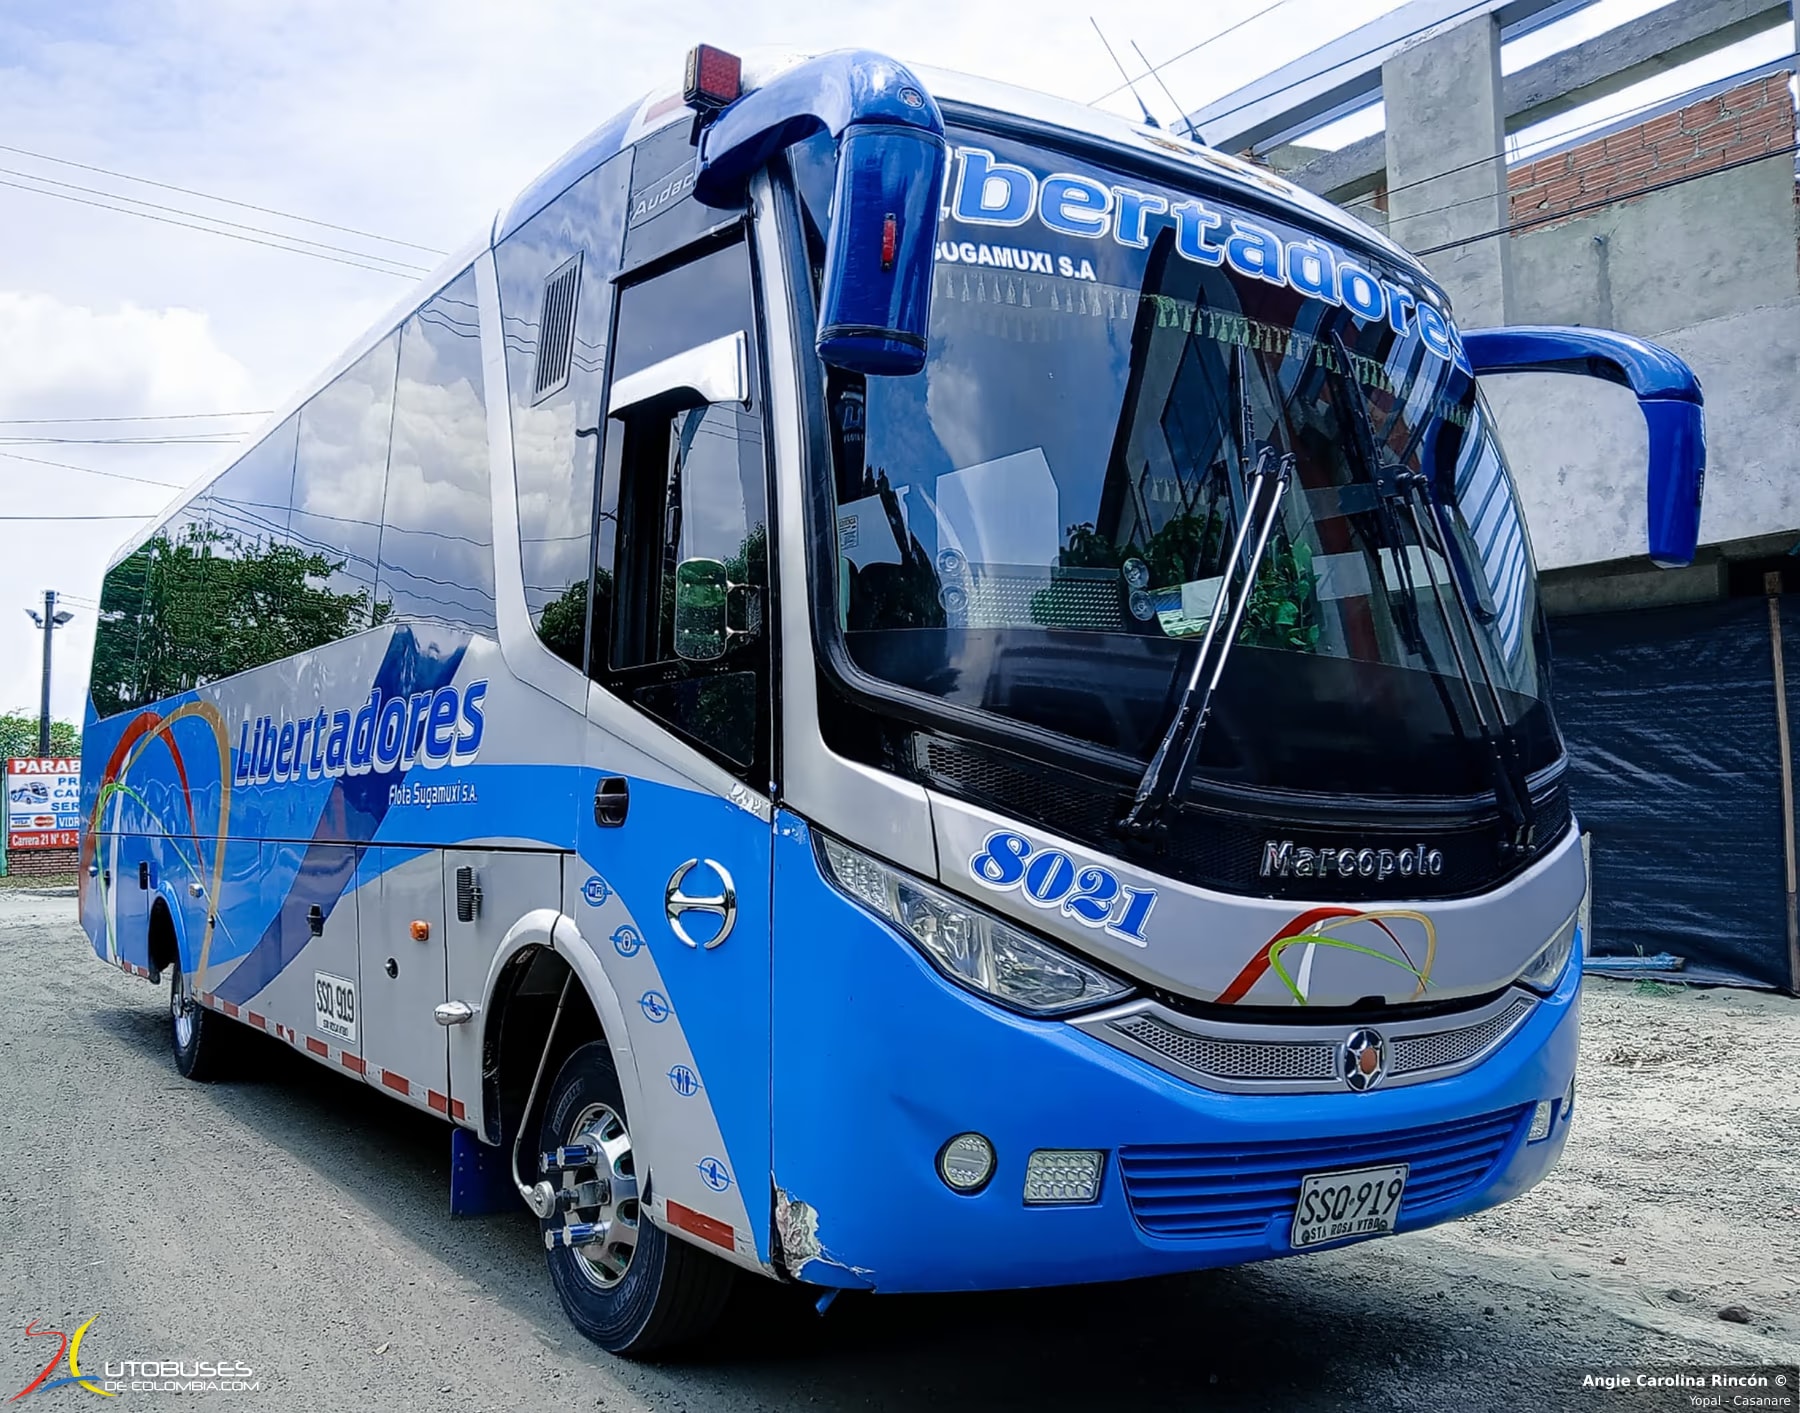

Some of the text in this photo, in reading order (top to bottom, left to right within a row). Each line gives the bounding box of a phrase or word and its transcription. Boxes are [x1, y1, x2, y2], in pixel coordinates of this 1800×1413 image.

[938, 145, 1474, 378] bertadores
[1059, 254, 1097, 282] S.A
[234, 678, 489, 787] Libertadores
[412, 779, 461, 809] Sugamuxi
[968, 829, 1159, 948] 8021
[1259, 840, 1444, 881] Marcopolo
